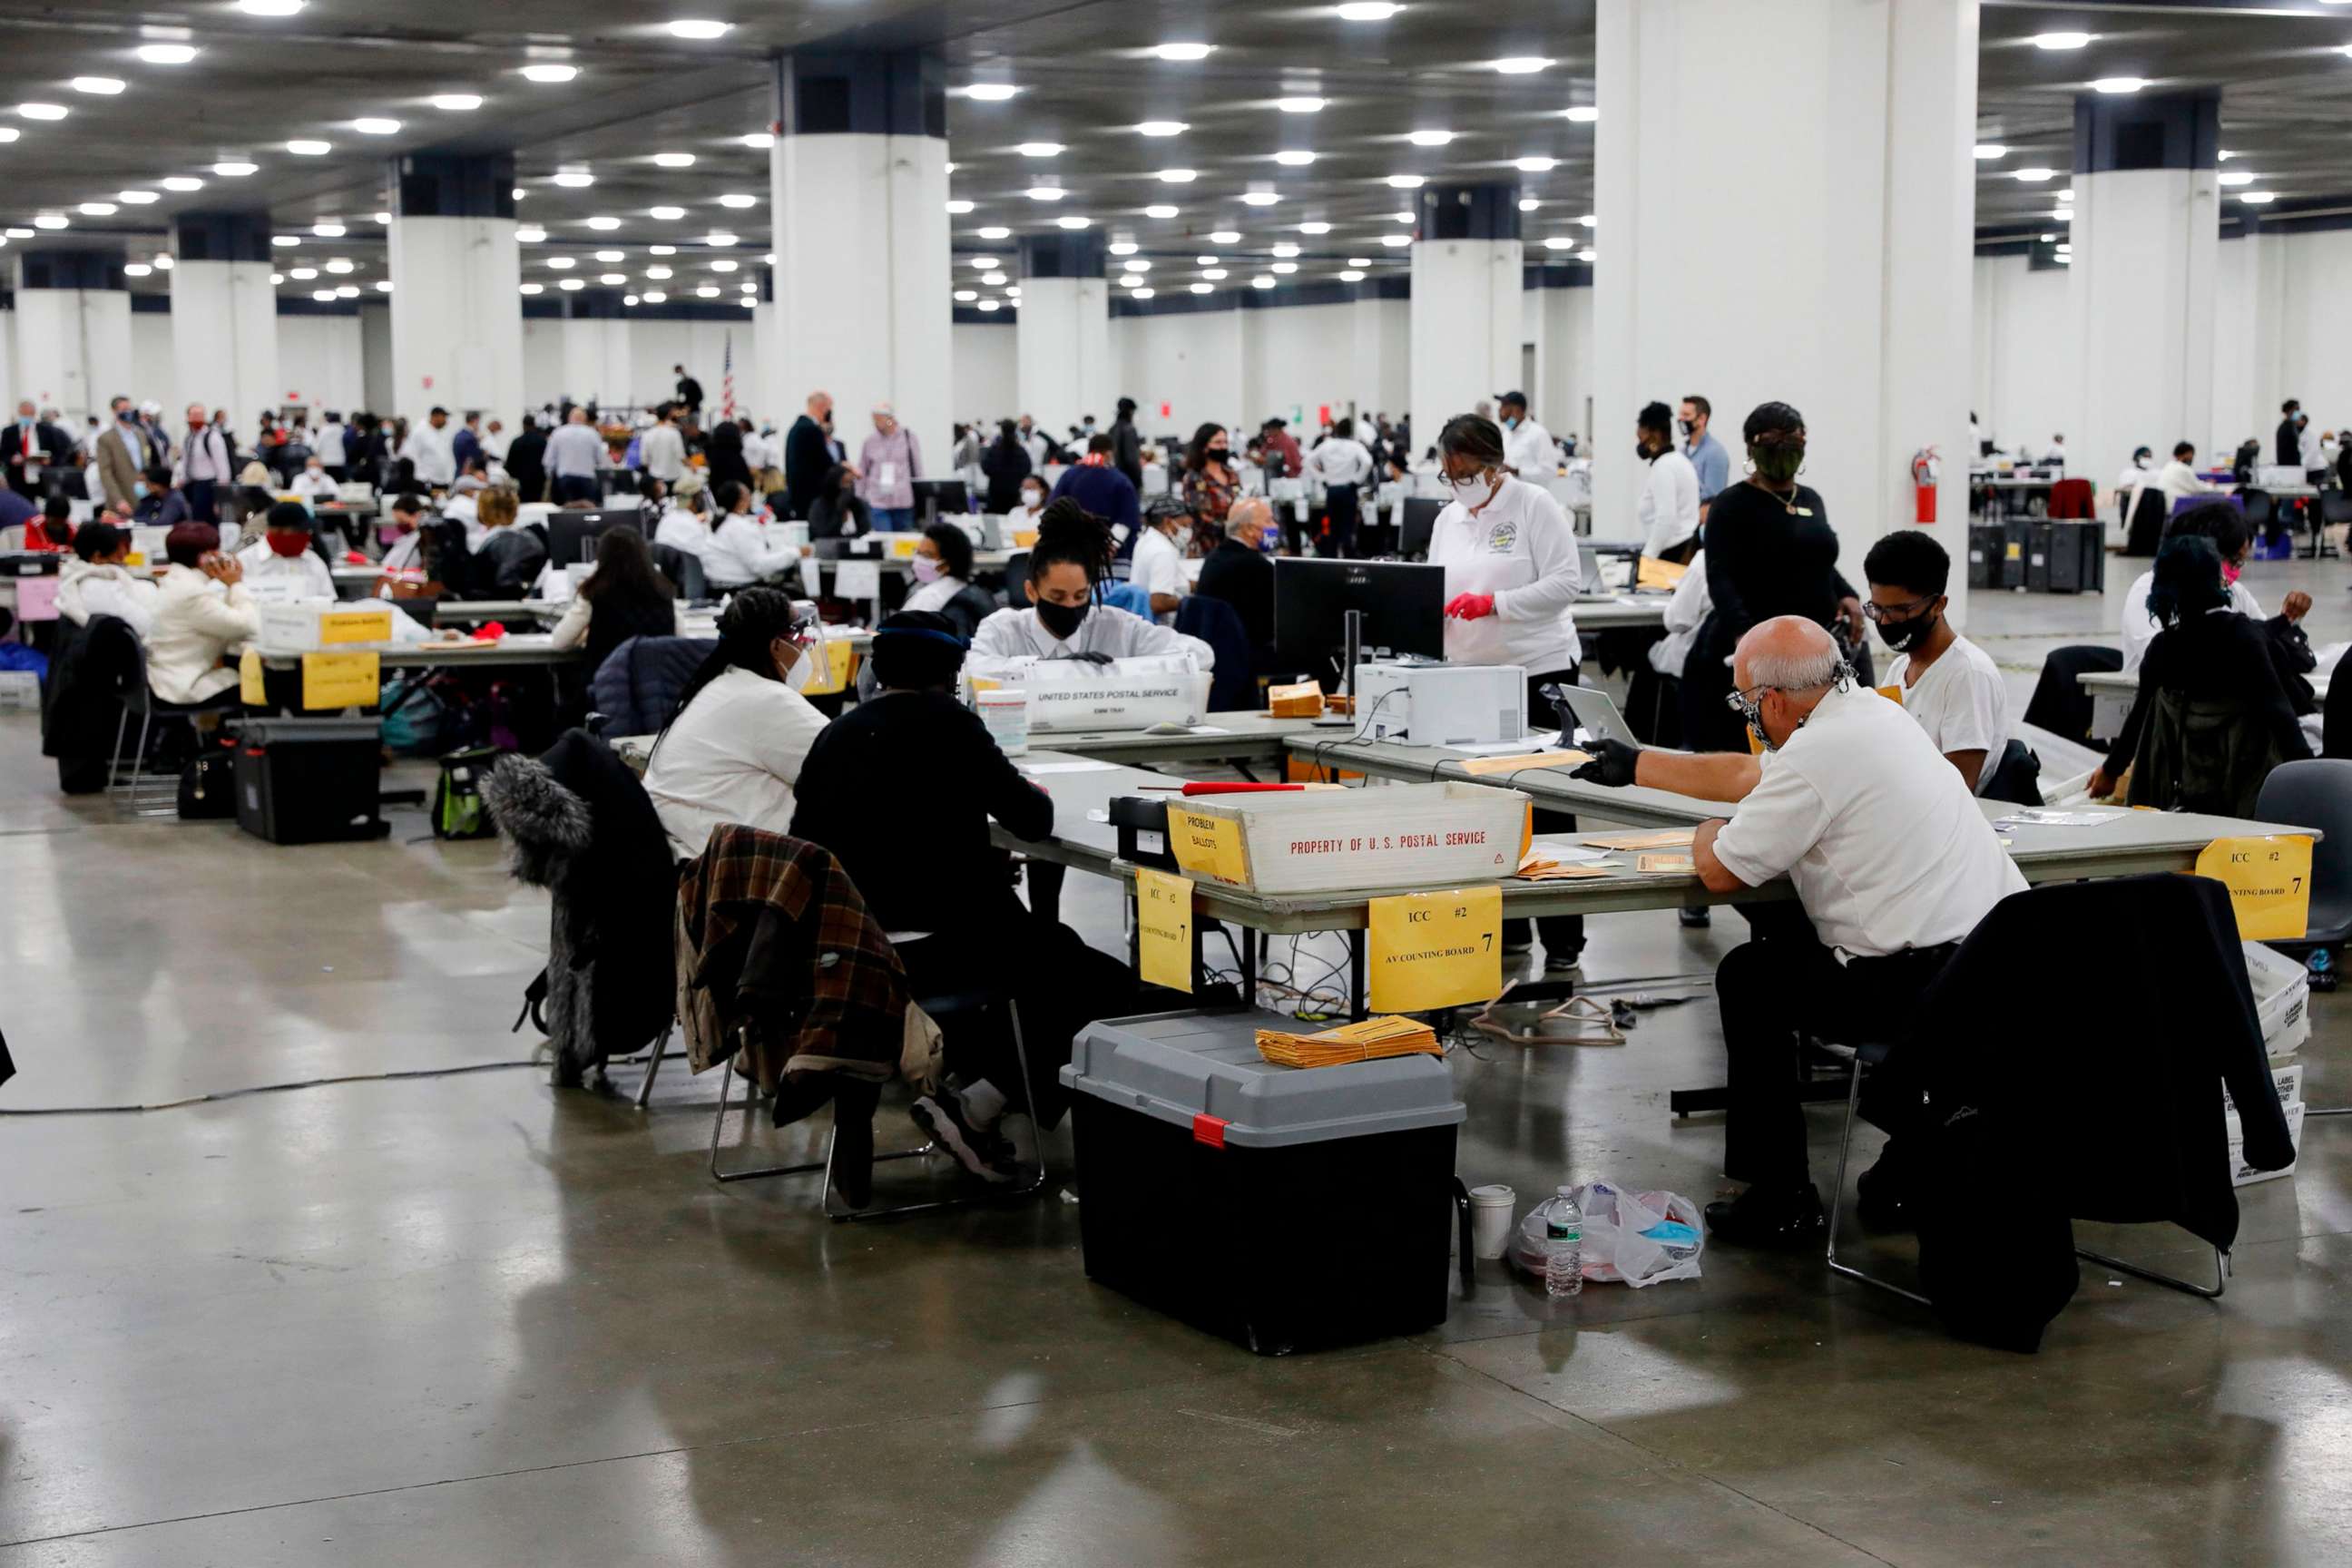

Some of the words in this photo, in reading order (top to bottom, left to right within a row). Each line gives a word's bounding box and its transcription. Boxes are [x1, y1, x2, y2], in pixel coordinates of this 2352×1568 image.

[1038, 691, 1071, 701] UNITED
[1072, 691, 1104, 701] STATES
[1107, 690, 1140, 700] POSTAL
[1142, 688, 1179, 698] SERVICE
[1187, 816, 1215, 830] PROBLEM
[1191, 835, 1217, 849] BALLOTS
[1290, 839, 1343, 855] PROPERTY
[1350, 838, 1362, 851] OF
[1400, 834, 1438, 848] POSTAL
[1446, 831, 1485, 846] SERVICE
[2231, 853, 2250, 863] ICC
[2269, 851, 2279, 861] #2
[2292, 877, 2301, 894] 7
[1150, 887, 1161, 900] ICC
[1408, 910, 1431, 922] ICC
[1455, 906, 1467, 917] #2
[1181, 924, 1186, 943] 7
[1386, 956, 1399, 964] AV
[1400, 951, 1443, 963] COUNTING
[1445, 946, 1475, 956] BOARD
[1482, 933, 1493, 952] 7
[2278, 1075, 2294, 1086] LABEL
